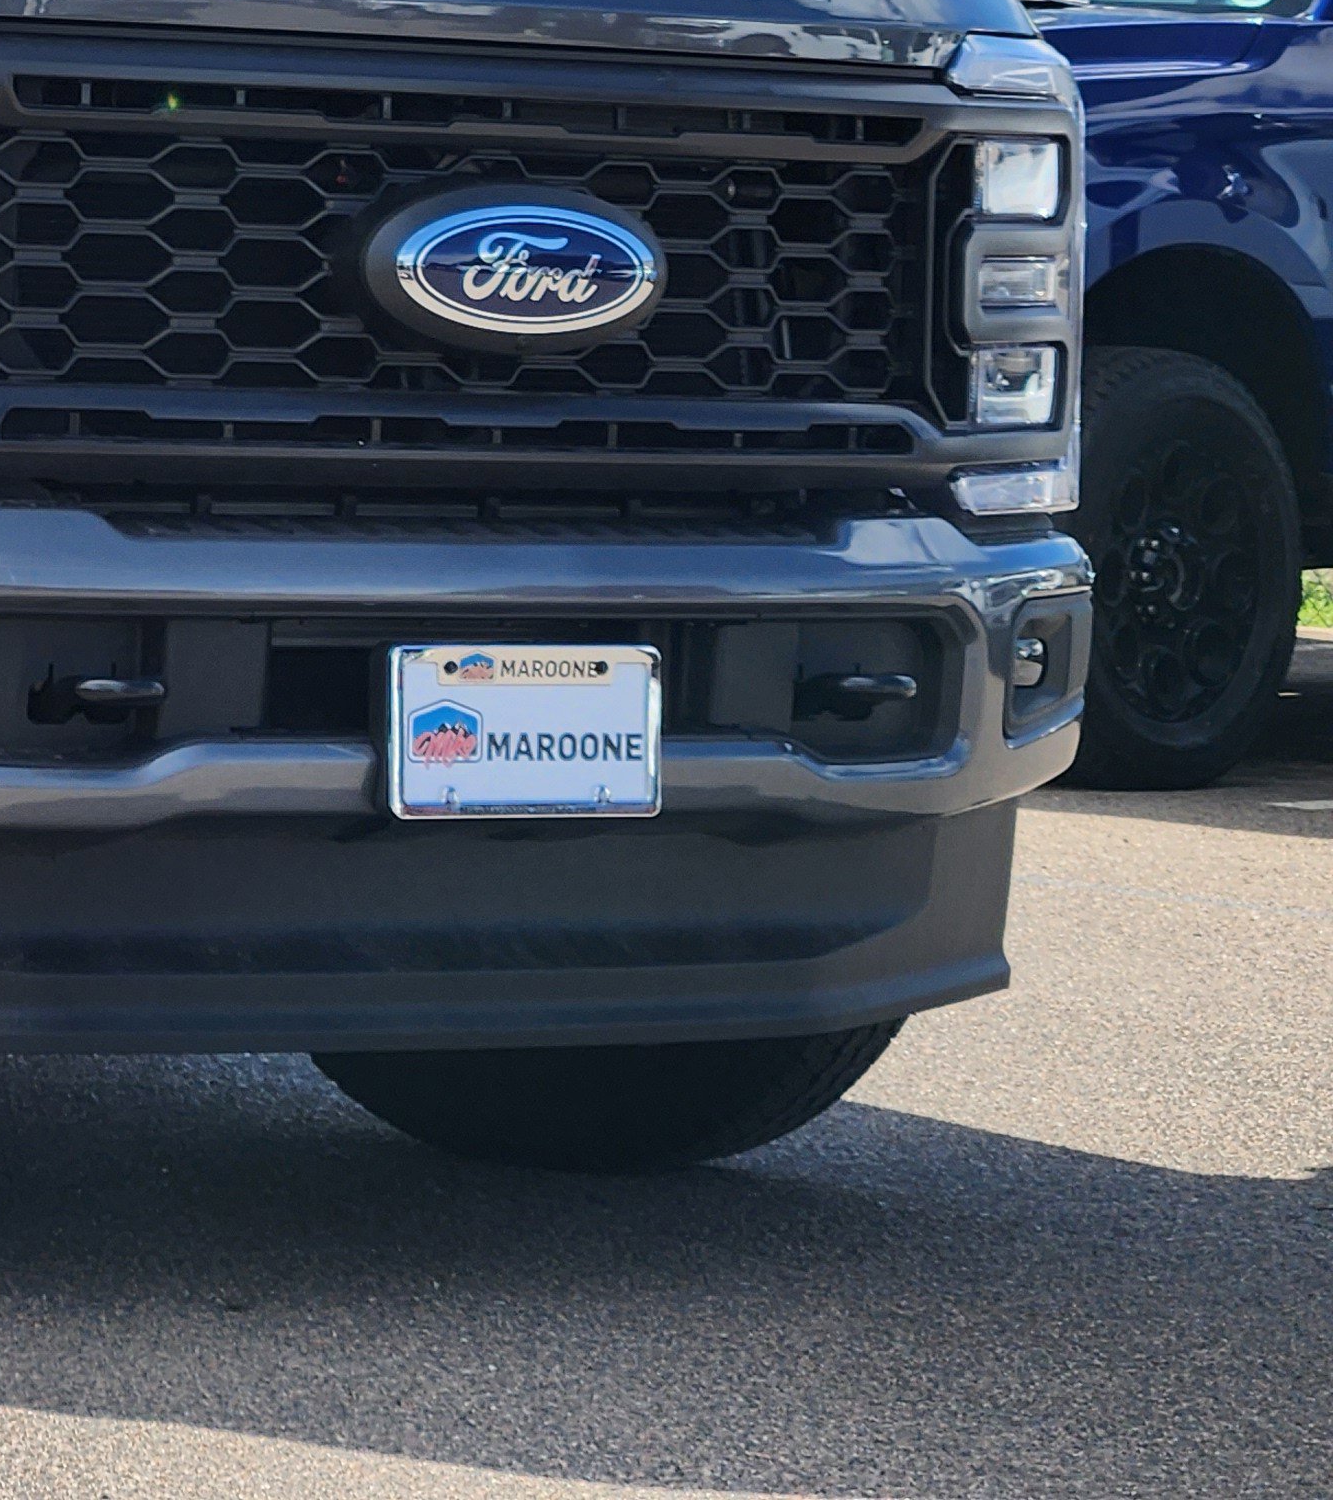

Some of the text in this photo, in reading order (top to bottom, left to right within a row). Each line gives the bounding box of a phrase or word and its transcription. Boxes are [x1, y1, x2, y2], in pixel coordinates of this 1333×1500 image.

[462, 230, 599, 303] Ford
[500, 660, 598, 678] MAROONE
[486, 732, 643, 762] MAROONE
